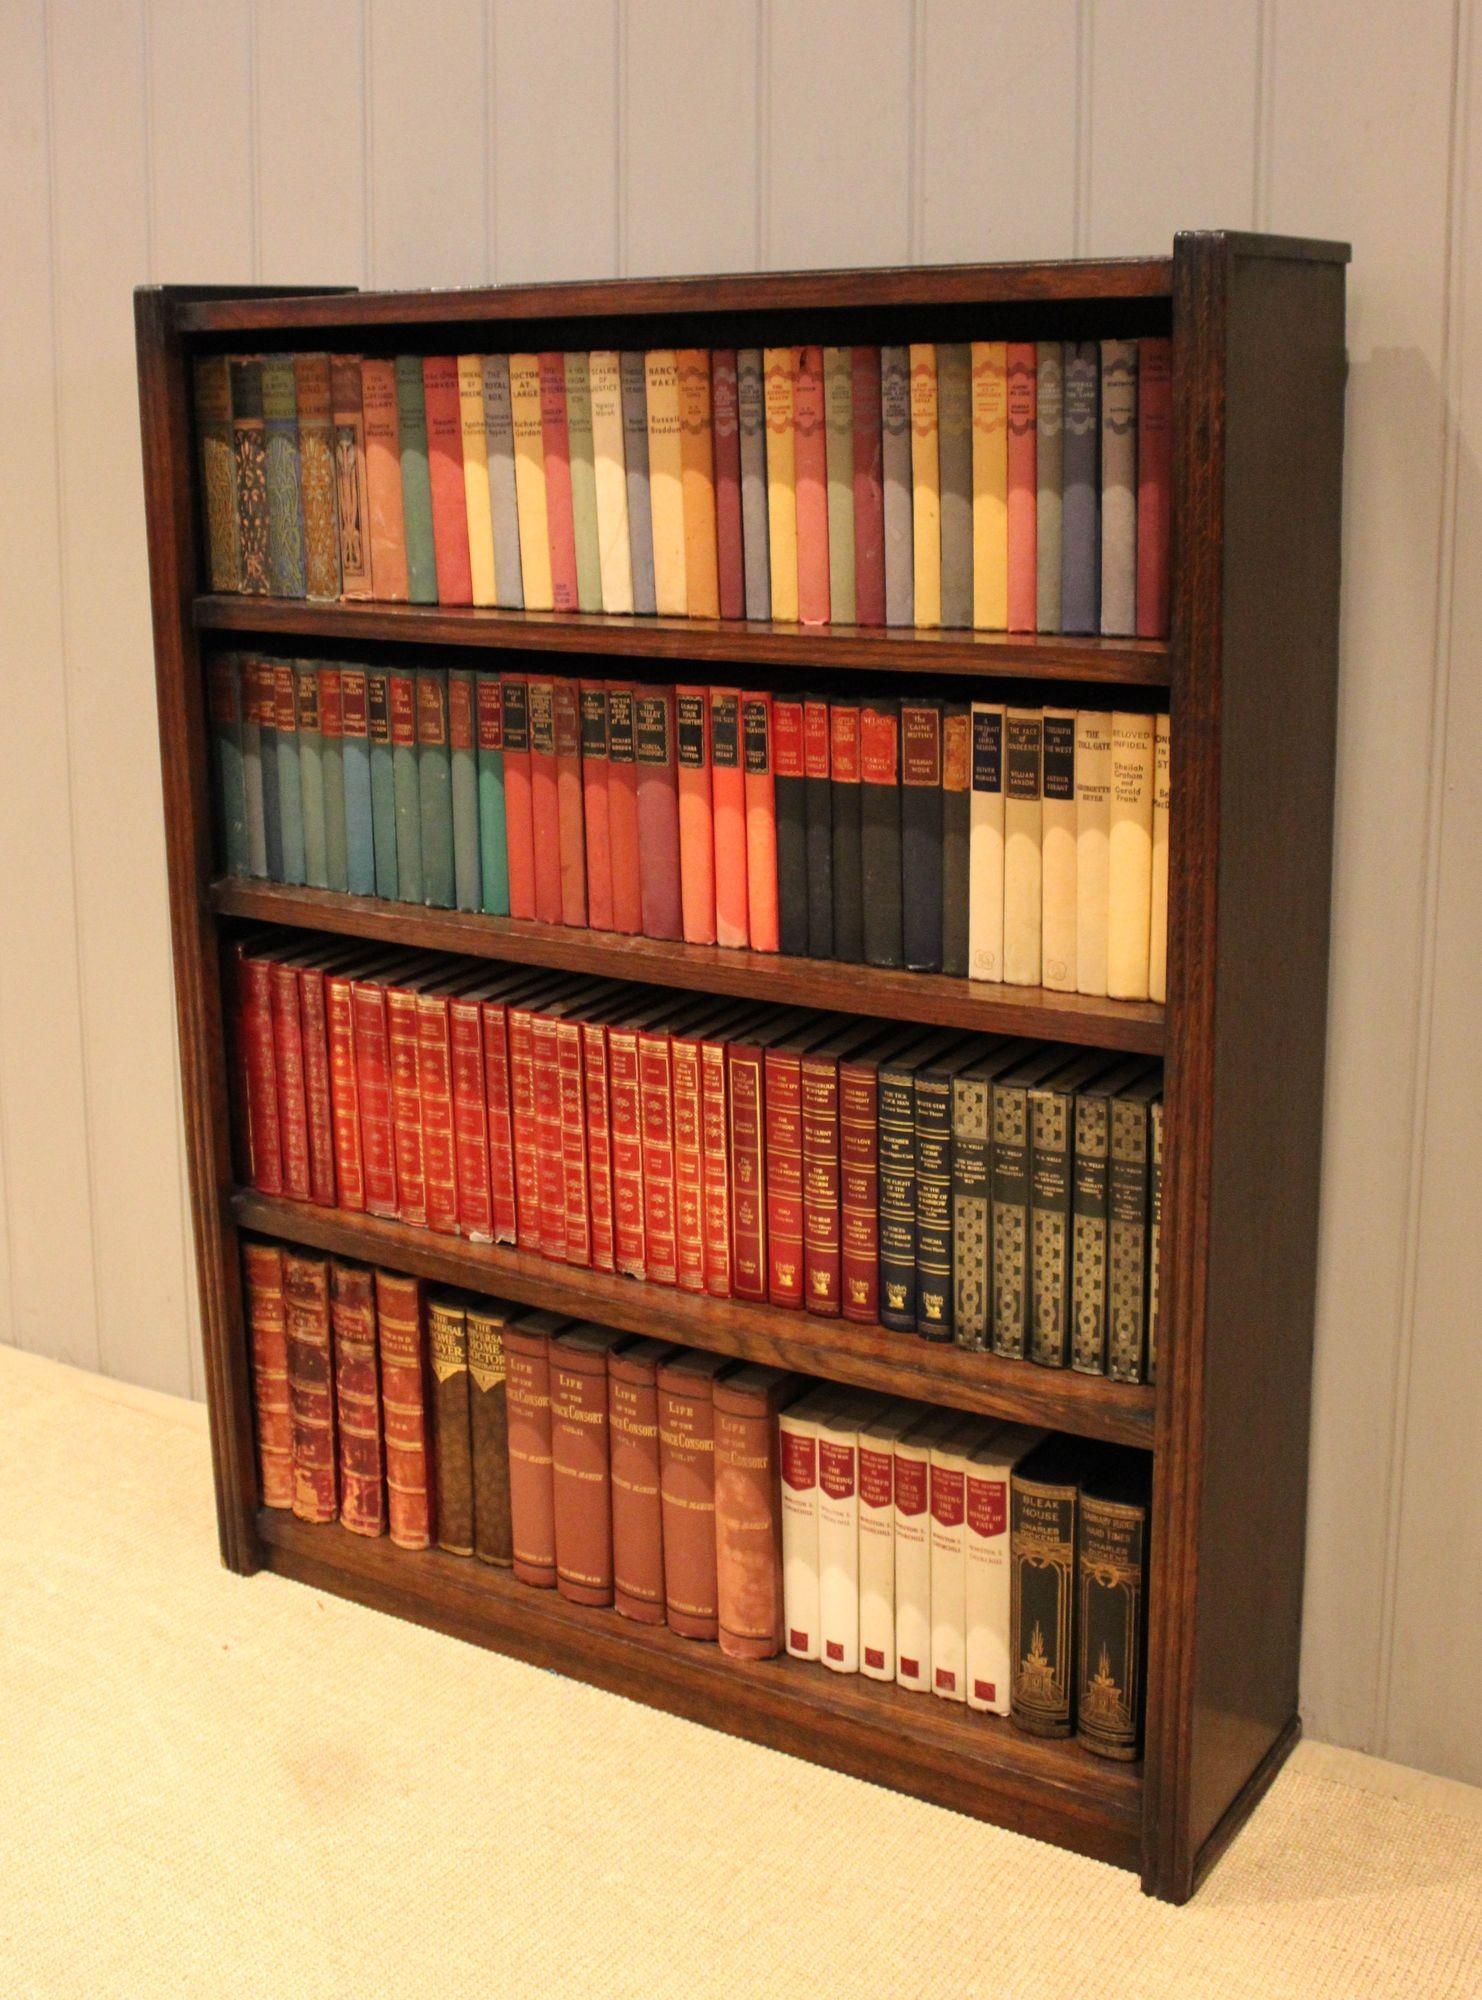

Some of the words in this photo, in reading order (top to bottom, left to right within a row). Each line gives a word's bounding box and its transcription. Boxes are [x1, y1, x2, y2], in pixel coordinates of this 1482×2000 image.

[647, 366, 679, 377] NANCY
[598, 376, 607, 384] OF
[651, 379, 677, 388] WAKE
[519, 381, 529, 389] AT
[513, 390, 538, 398] LARGE
[1114, 741, 1147, 750] INFIDEL
[1023, 1495, 1059, 1509] BLEAK
[1023, 1507, 1057, 1521] HOUSE
